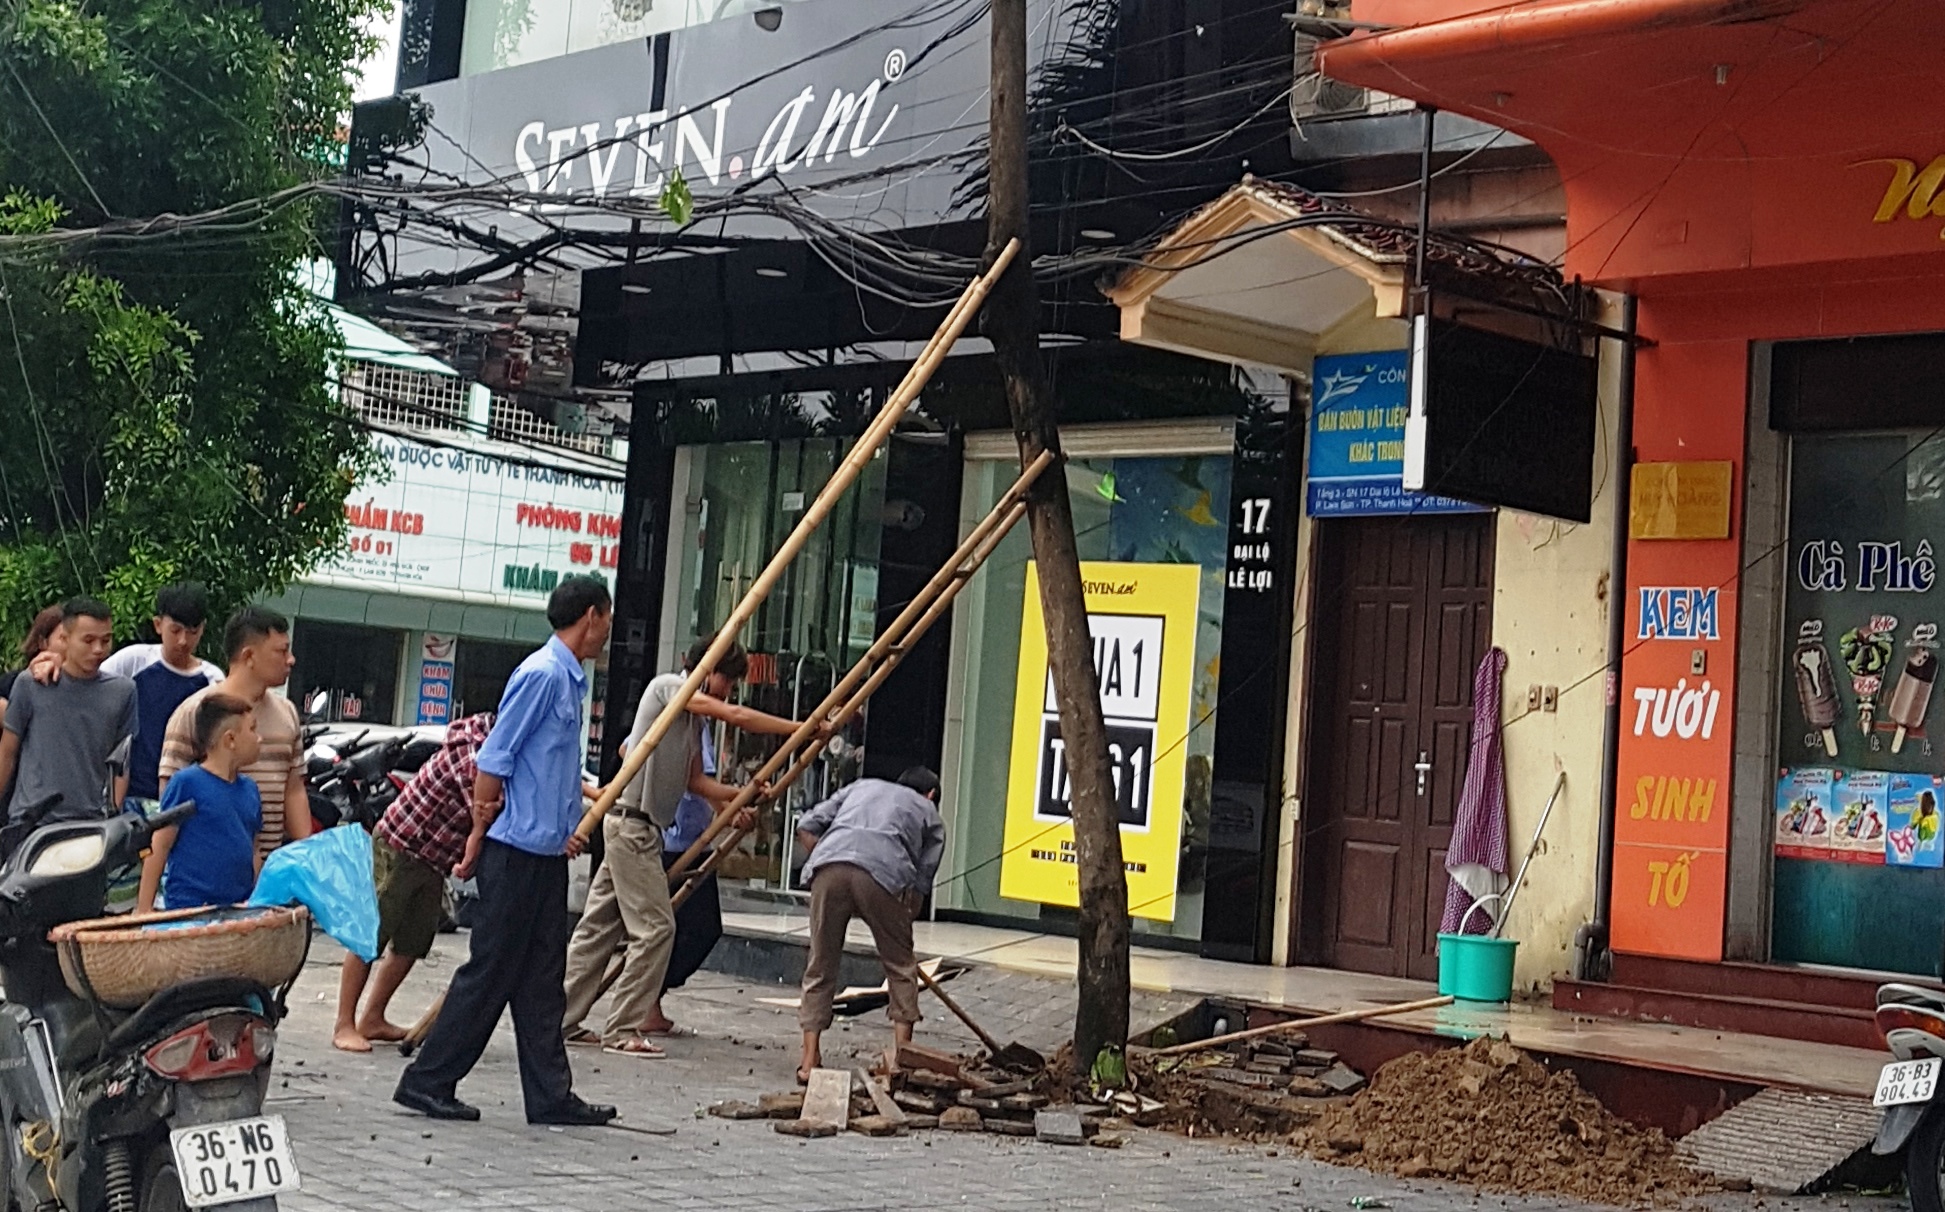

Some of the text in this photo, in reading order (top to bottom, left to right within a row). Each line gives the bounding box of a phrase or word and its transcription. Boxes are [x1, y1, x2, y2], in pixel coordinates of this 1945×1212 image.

[390, 509, 424, 536] KCB
[516, 501, 581, 534] PHÒNG
[1241, 498, 1272, 534] 17
[375, 540, 393, 556] 01
[1799, 539, 1937, 592] Cà Phê
[503, 562, 558, 594] KHÁM
[1228, 566, 1246, 588] LÊ
[1638, 586, 1720, 641] KEM
[1132, 639, 1144, 698] 1
[1633, 676, 1720, 740] TƯƠI
[1129, 746, 1144, 809] 1
[1630, 775, 1716, 823] SINH
[1646, 850, 1699, 908] TỐ
[1879, 1080, 1932, 1103] 904.43
[191, 1122, 275, 1162] 36-N6
[200, 1156, 283, 1197] 0470
